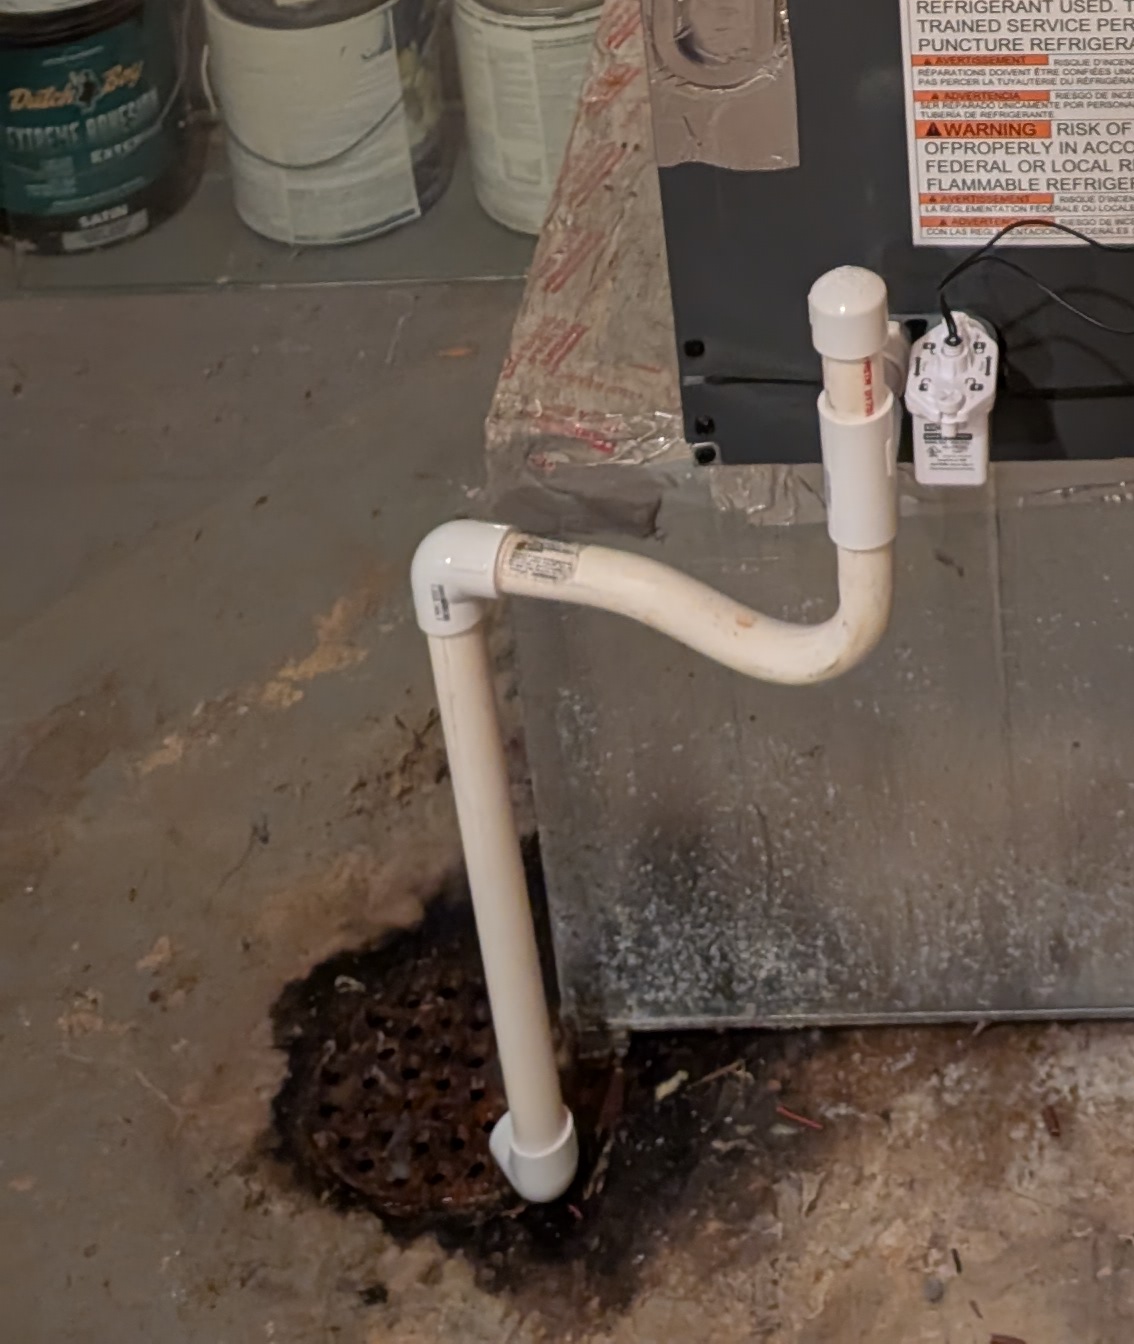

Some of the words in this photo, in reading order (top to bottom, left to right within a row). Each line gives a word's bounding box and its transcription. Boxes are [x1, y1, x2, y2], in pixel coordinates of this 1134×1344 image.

[916, 0, 1053, 13] REFRIGERANT
[917, 19, 1001, 33] TRAINED
[1007, 18, 1090, 32] SERVICE
[918, 37, 1023, 51] PUNCTURE
[944, 122, 1037, 136] WARNING
[1057, 122, 1100, 136] RISK
[1106, 122, 1131, 135] OF
[924, 141, 1053, 155] OFPROPERLY
[1059, 140, 1077, 154] IN
[926, 159, 1011, 173] FEDERAL
[1017, 159, 1045, 172] OR
[1051, 158, 1113, 172] LOCAL
[927, 178, 1039, 192] FLAMMABLE
